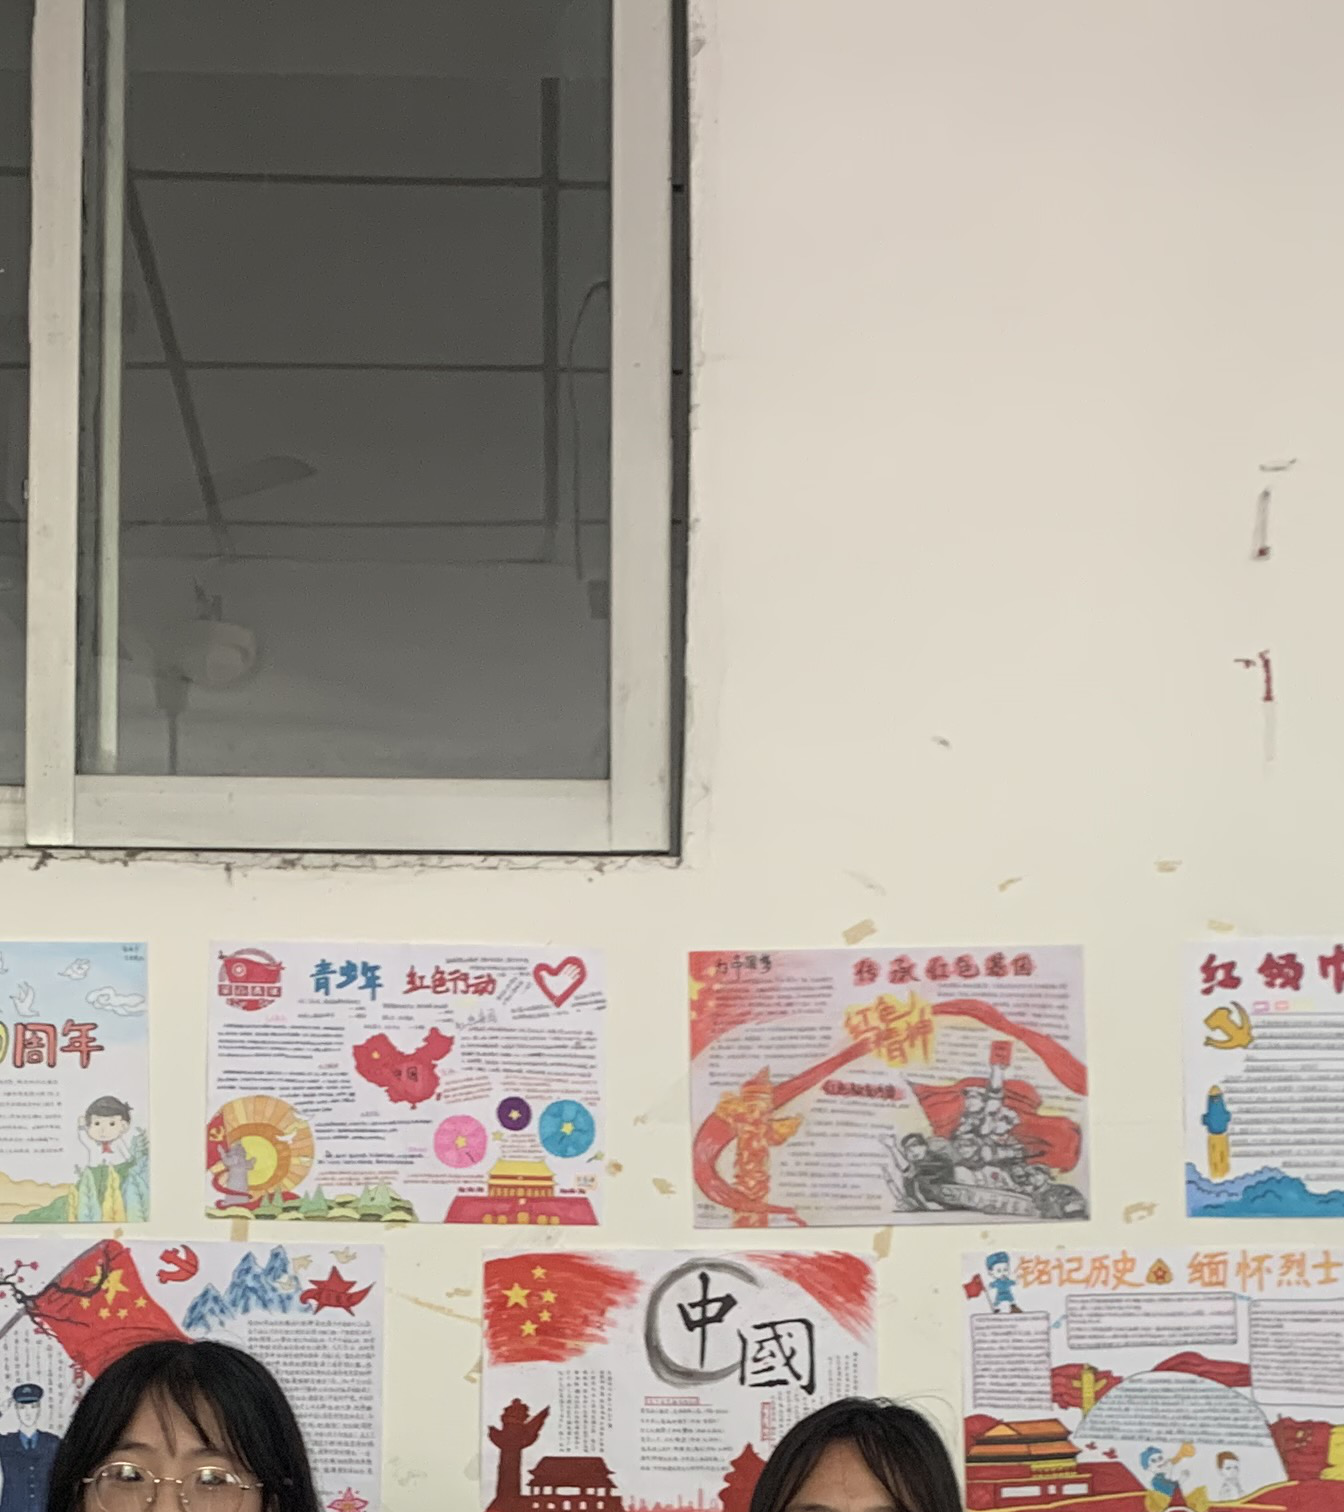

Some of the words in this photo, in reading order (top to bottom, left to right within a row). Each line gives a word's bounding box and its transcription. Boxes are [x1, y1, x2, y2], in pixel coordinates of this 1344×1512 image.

[309, 958, 385, 1000] 青少年
[1016, 1249, 1145, 1290] 铭记历史
[1186, 1251, 1344, 1292] 缅怀烈士
